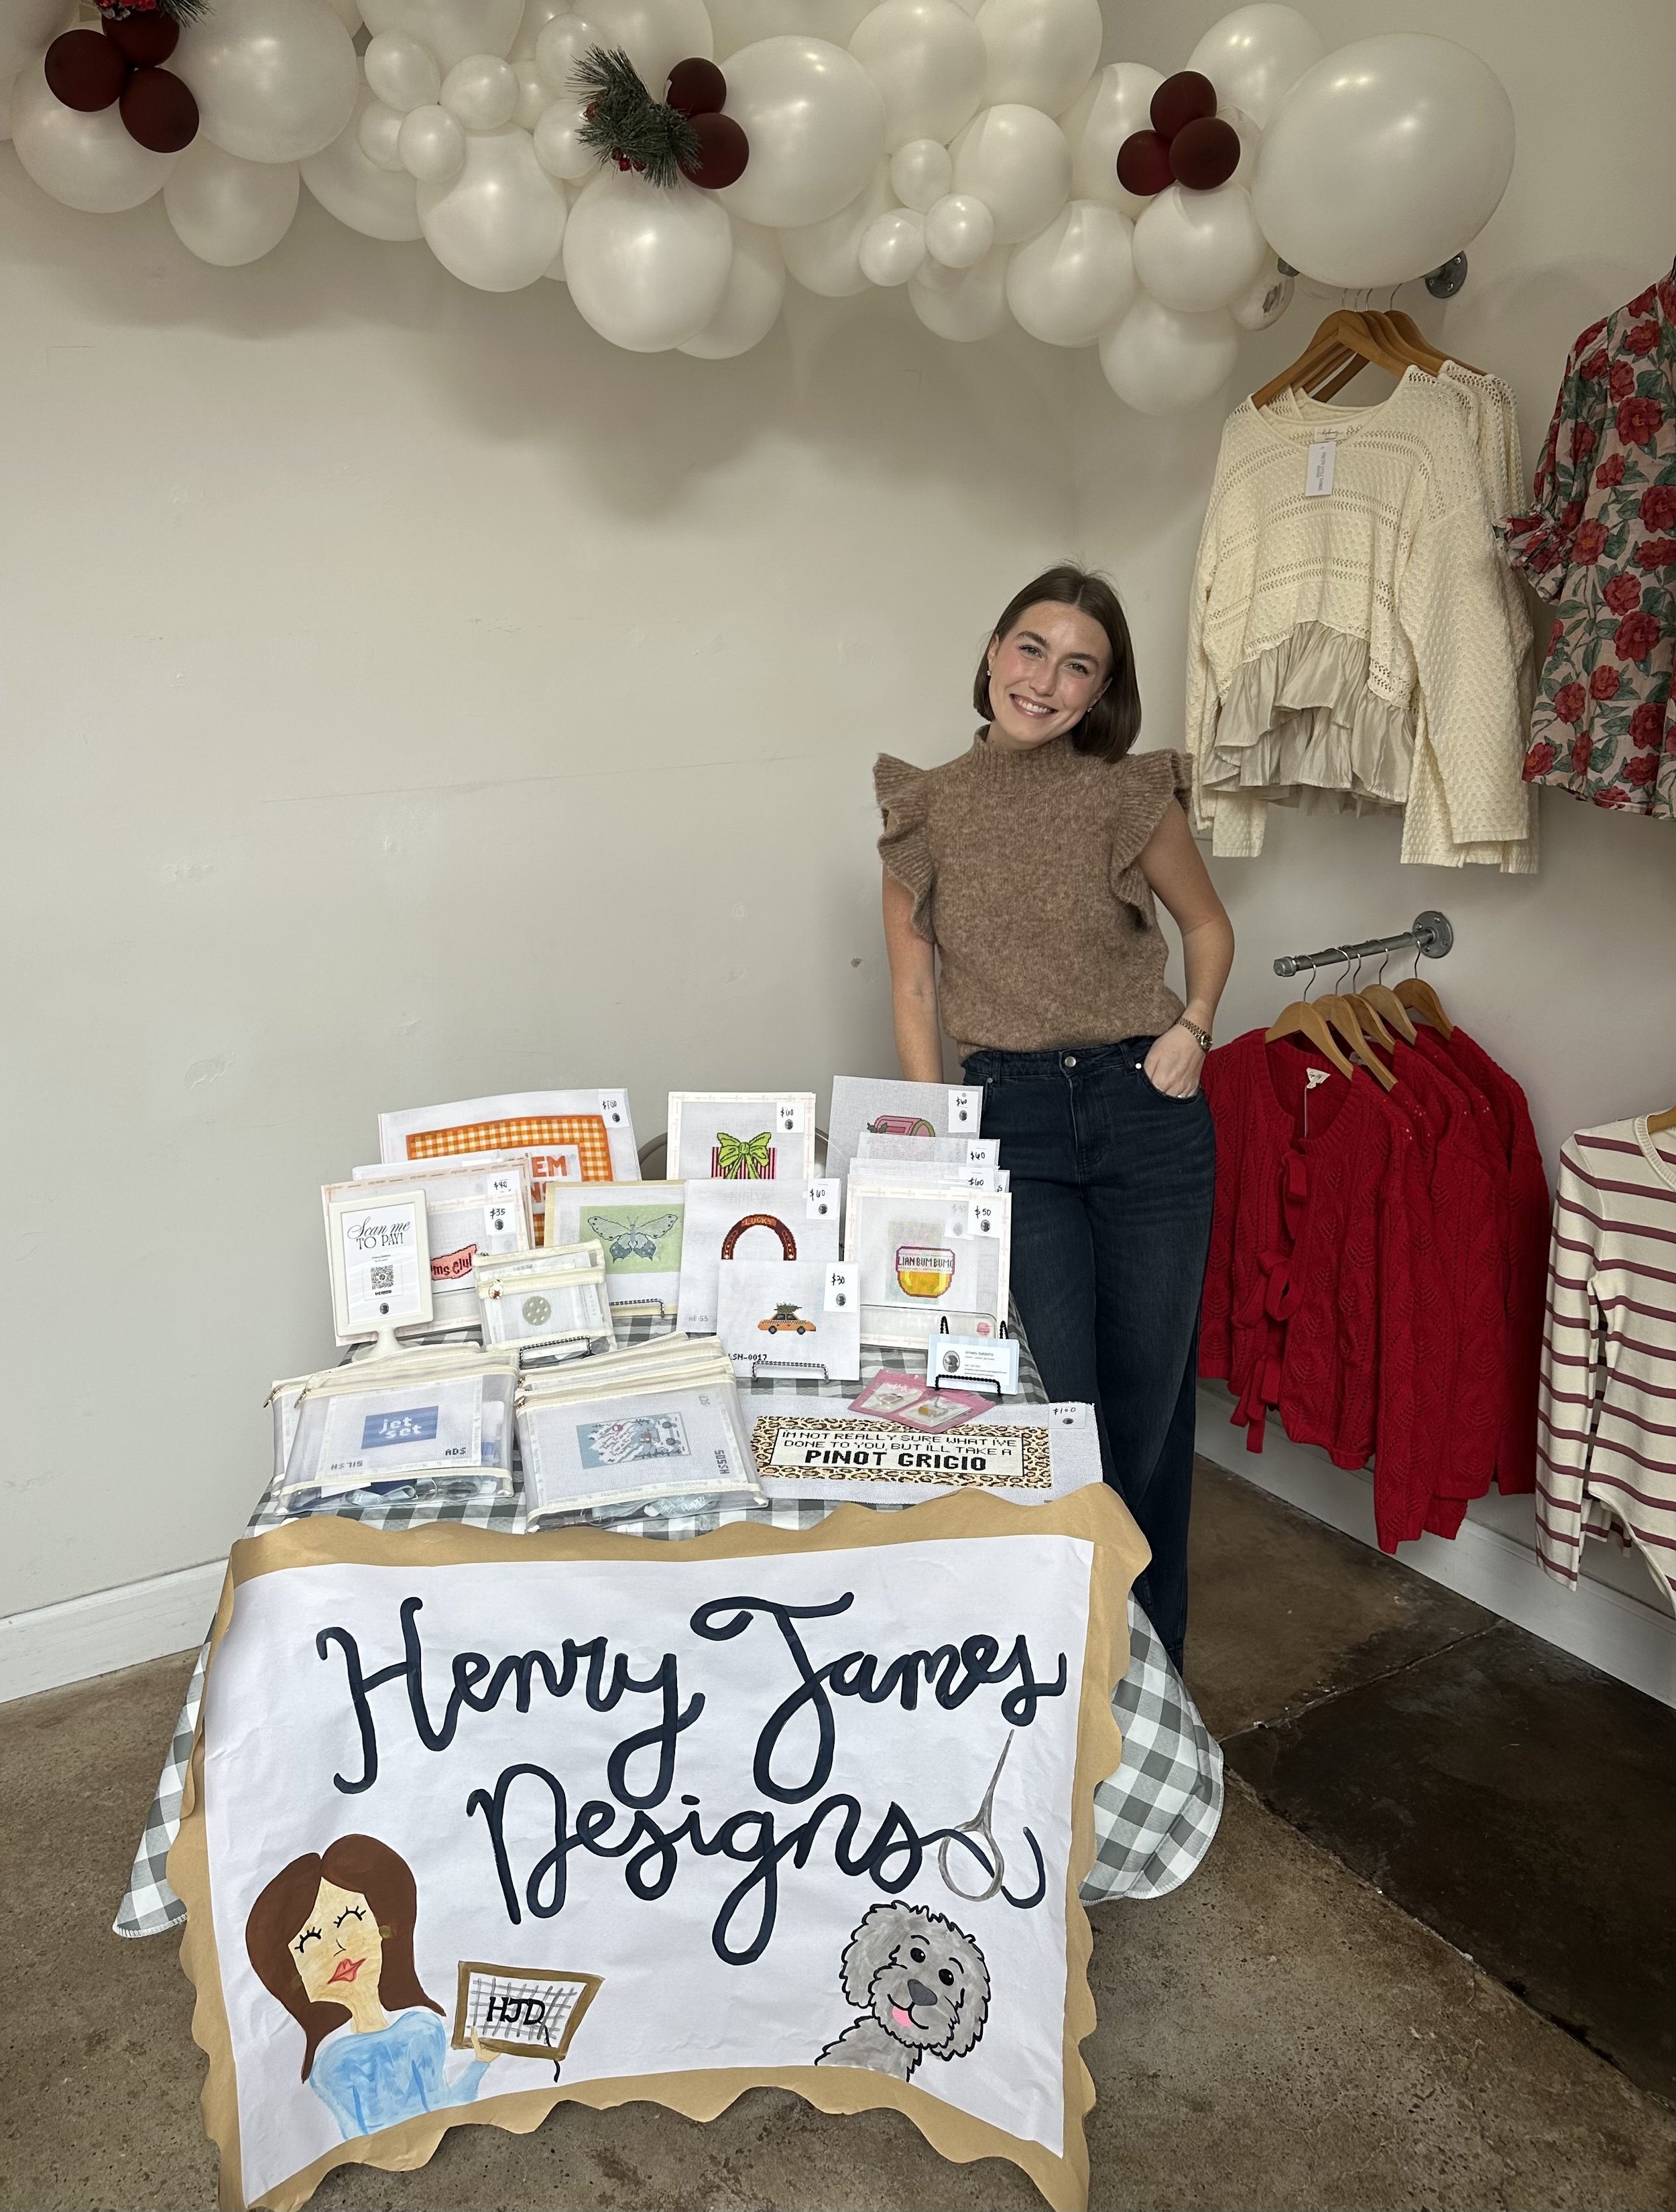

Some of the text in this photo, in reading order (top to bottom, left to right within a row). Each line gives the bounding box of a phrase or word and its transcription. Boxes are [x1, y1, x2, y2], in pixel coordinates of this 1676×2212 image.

[810, 1188, 825, 1201] $60
[489, 1208, 506, 1219] $35
[974, 1205, 992, 1219] $50
[347, 1216, 411, 1239] Scan me
[744, 1217, 772, 1225] LUCKY
[356, 1232, 404, 1249] TO PAY!
[831, 1273, 845, 1286] $30
[1053, 1407, 1077, 1415] $100
[379, 1416, 412, 1434] jet
[385, 1424, 422, 1439] set
[834, 1433, 897, 1441] REALLY
[900, 1434, 942, 1443] SURE
[946, 1436, 988, 1446] WHAT
[445, 1447, 467, 1456] ADS
[784, 1440, 825, 1449] DONE
[853, 1442, 888, 1451] YOU,
[891, 1443, 921, 1451] BUT
[955, 1446, 998, 1455] TAKE
[804, 1450, 987, 1471] PINOT GRIGIO
[316, 1591, 1067, 1810] Henry James
[466, 1763, 972, 1966] Designs
[486, 1996, 546, 2026] HJD
